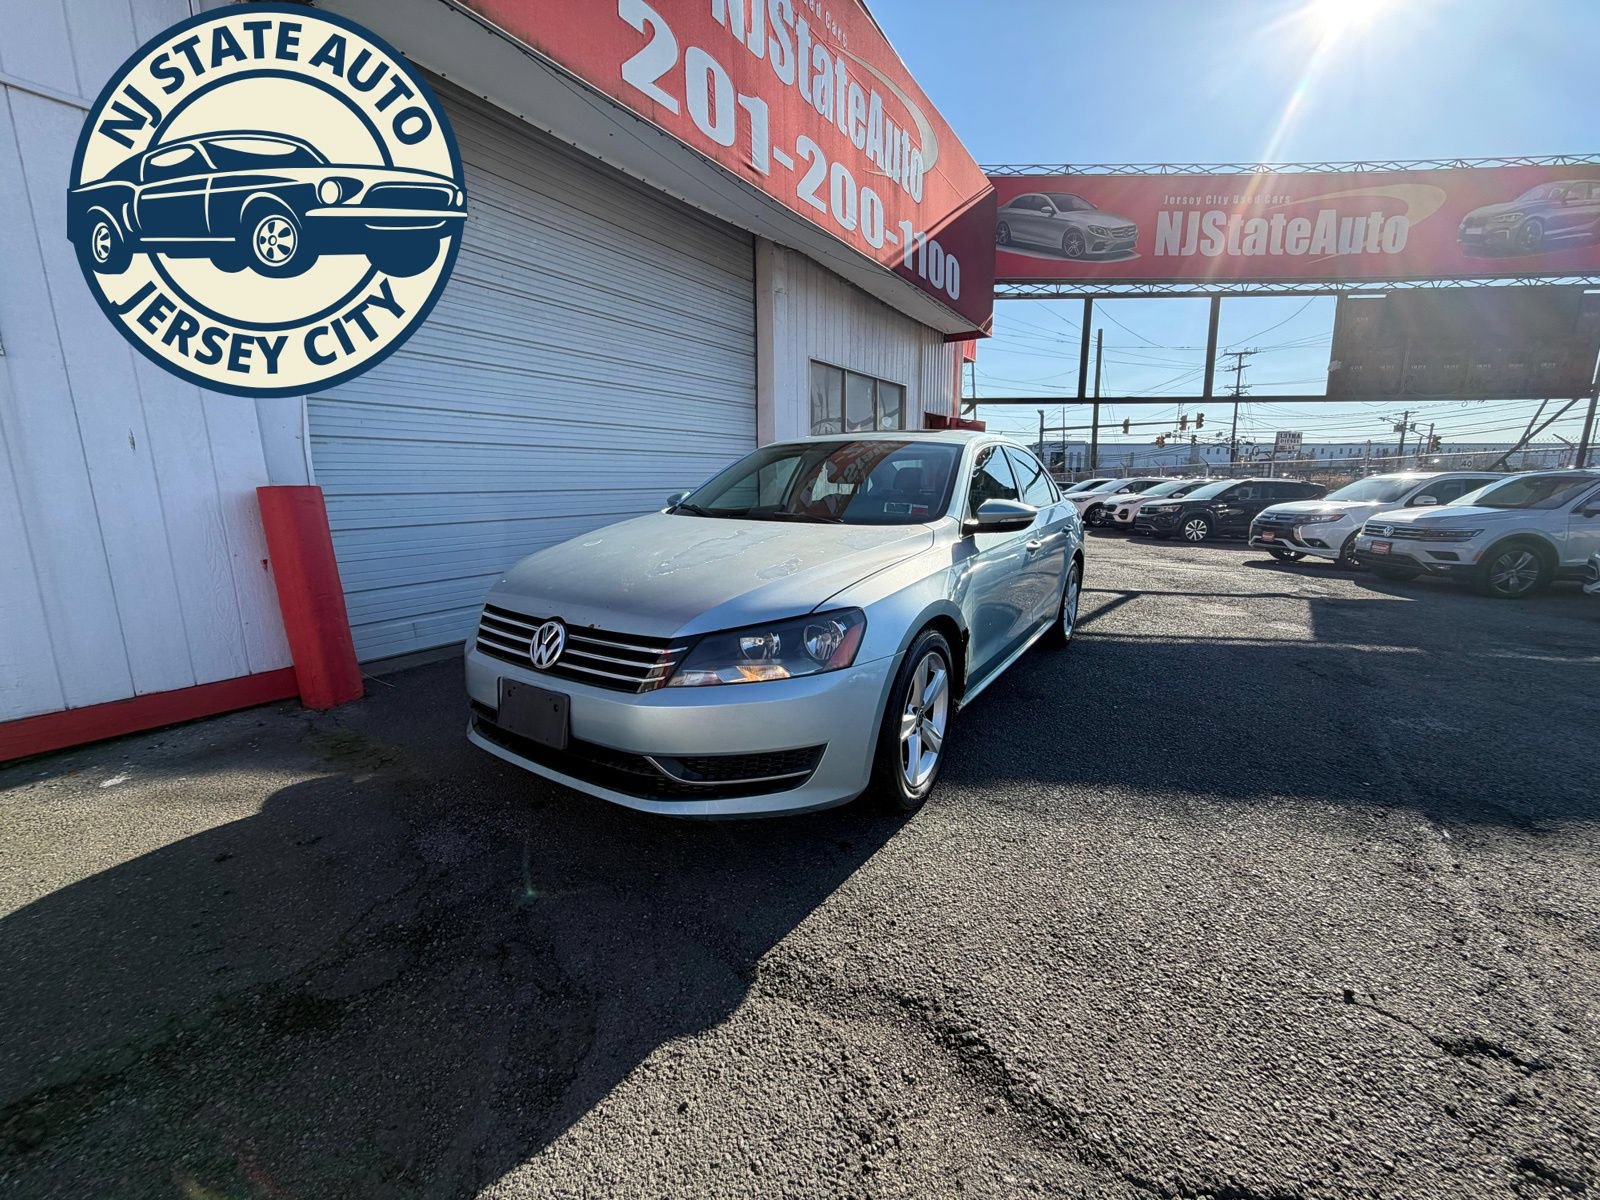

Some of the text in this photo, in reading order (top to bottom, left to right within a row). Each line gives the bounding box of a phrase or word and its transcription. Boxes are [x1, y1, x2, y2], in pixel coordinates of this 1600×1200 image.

[618, 0, 961, 301] 201-200-1100
[1163, 194, 1291, 206] Jersey City Used Cars
[1154, 209, 1408, 257] NJStateAuto
